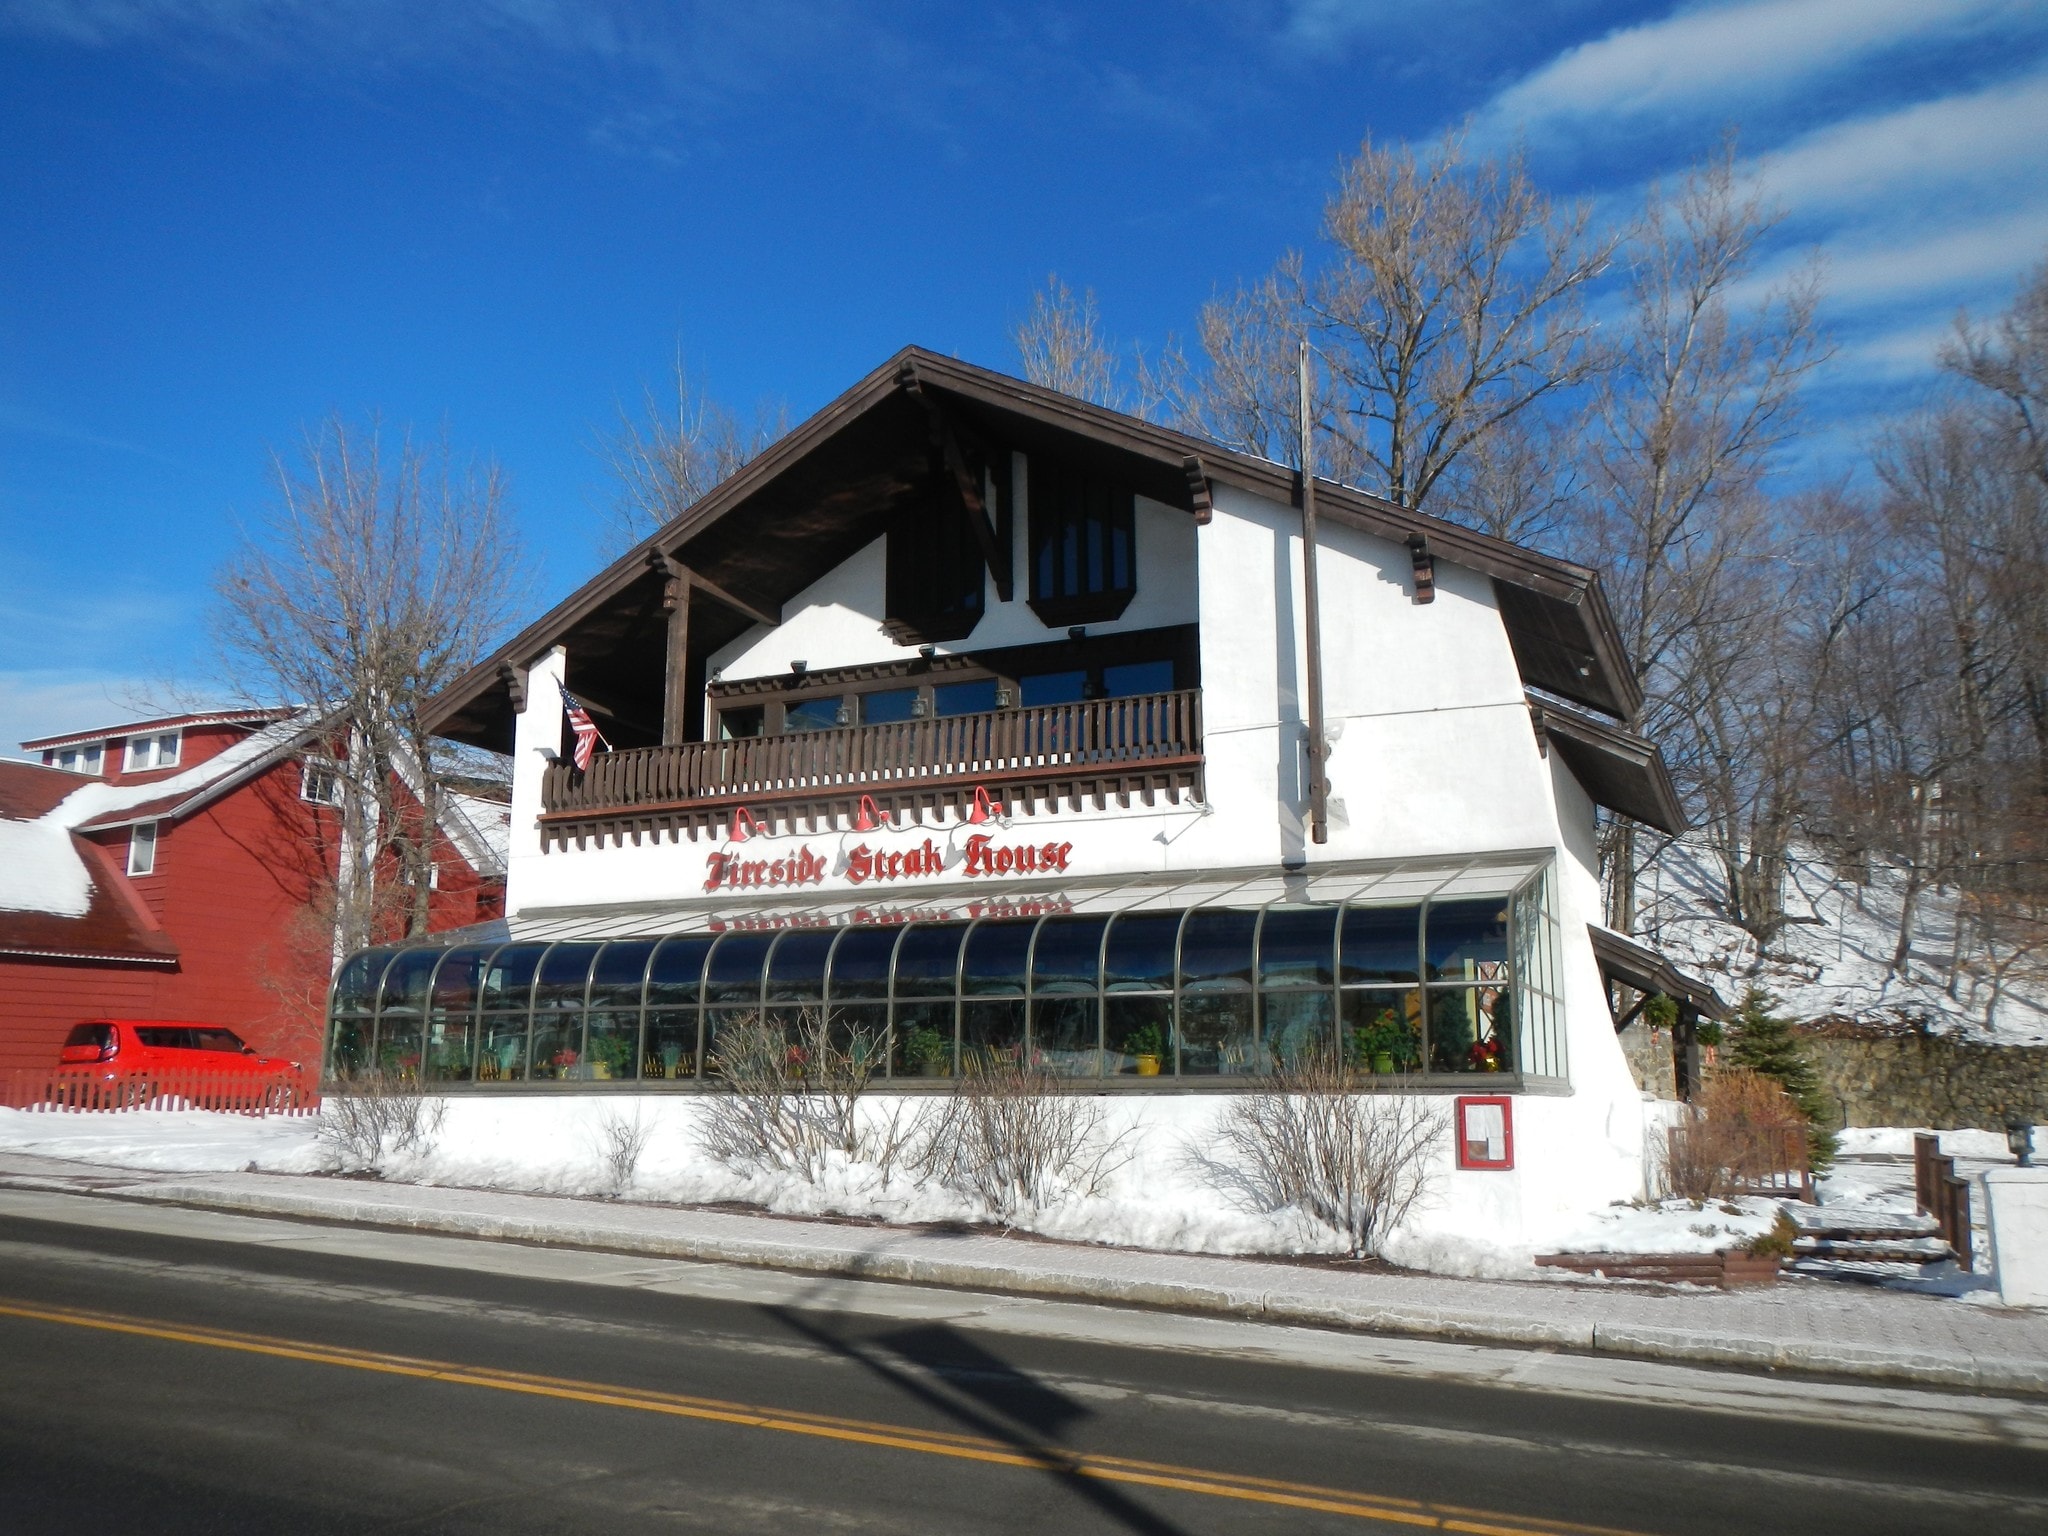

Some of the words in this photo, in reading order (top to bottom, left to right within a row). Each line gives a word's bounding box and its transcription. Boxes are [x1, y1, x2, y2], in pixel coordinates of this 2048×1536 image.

[703, 843, 827, 892] Fireside
[844, 838, 945, 885] Steak
[963, 834, 1073, 877] House
